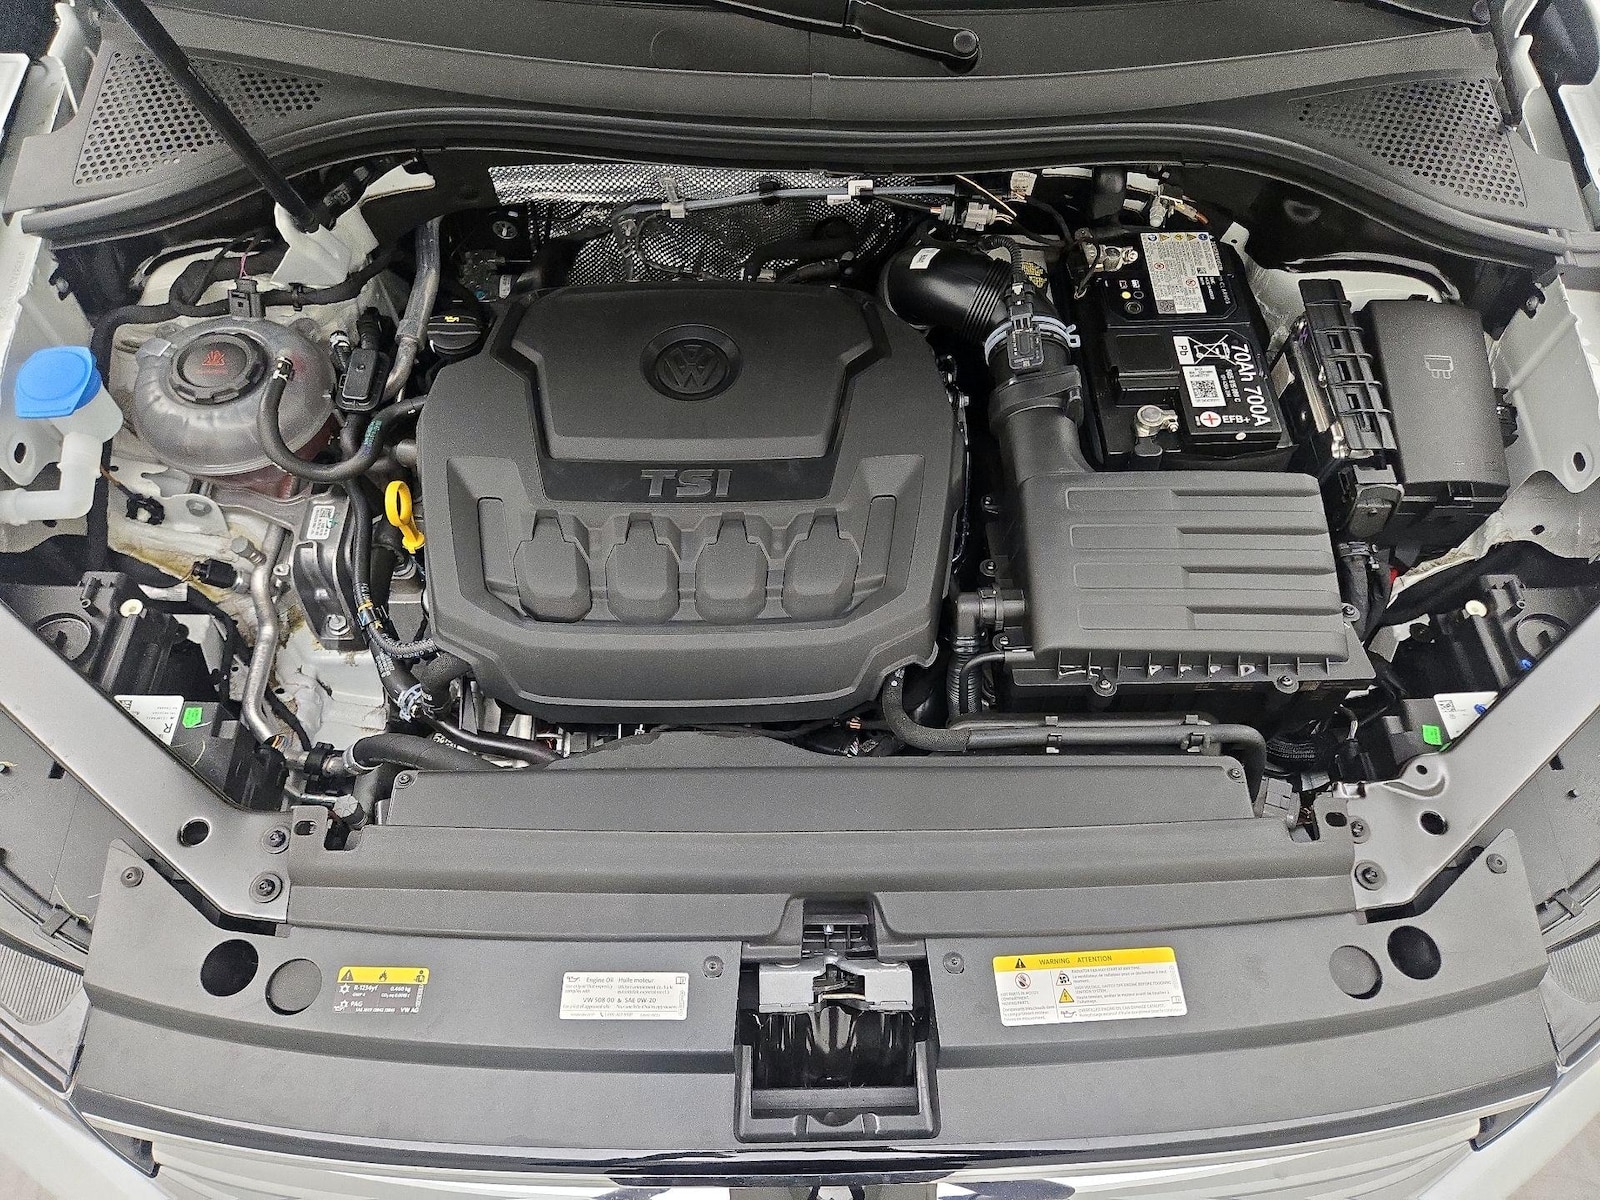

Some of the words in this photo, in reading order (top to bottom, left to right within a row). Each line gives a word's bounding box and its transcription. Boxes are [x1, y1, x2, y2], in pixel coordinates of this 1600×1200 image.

[1177, 345, 1188, 356] Pb
[1231, 343, 1257, 382] 70Ah
[1243, 385, 1271, 427] 700A
[1222, 415, 1251, 424] EFB+
[641, 469, 733, 498] TSI
[1039, 957, 1071, 966] WARNING
[1077, 955, 1113, 963] ATTENTION
[586, 976, 605, 984] Engine
